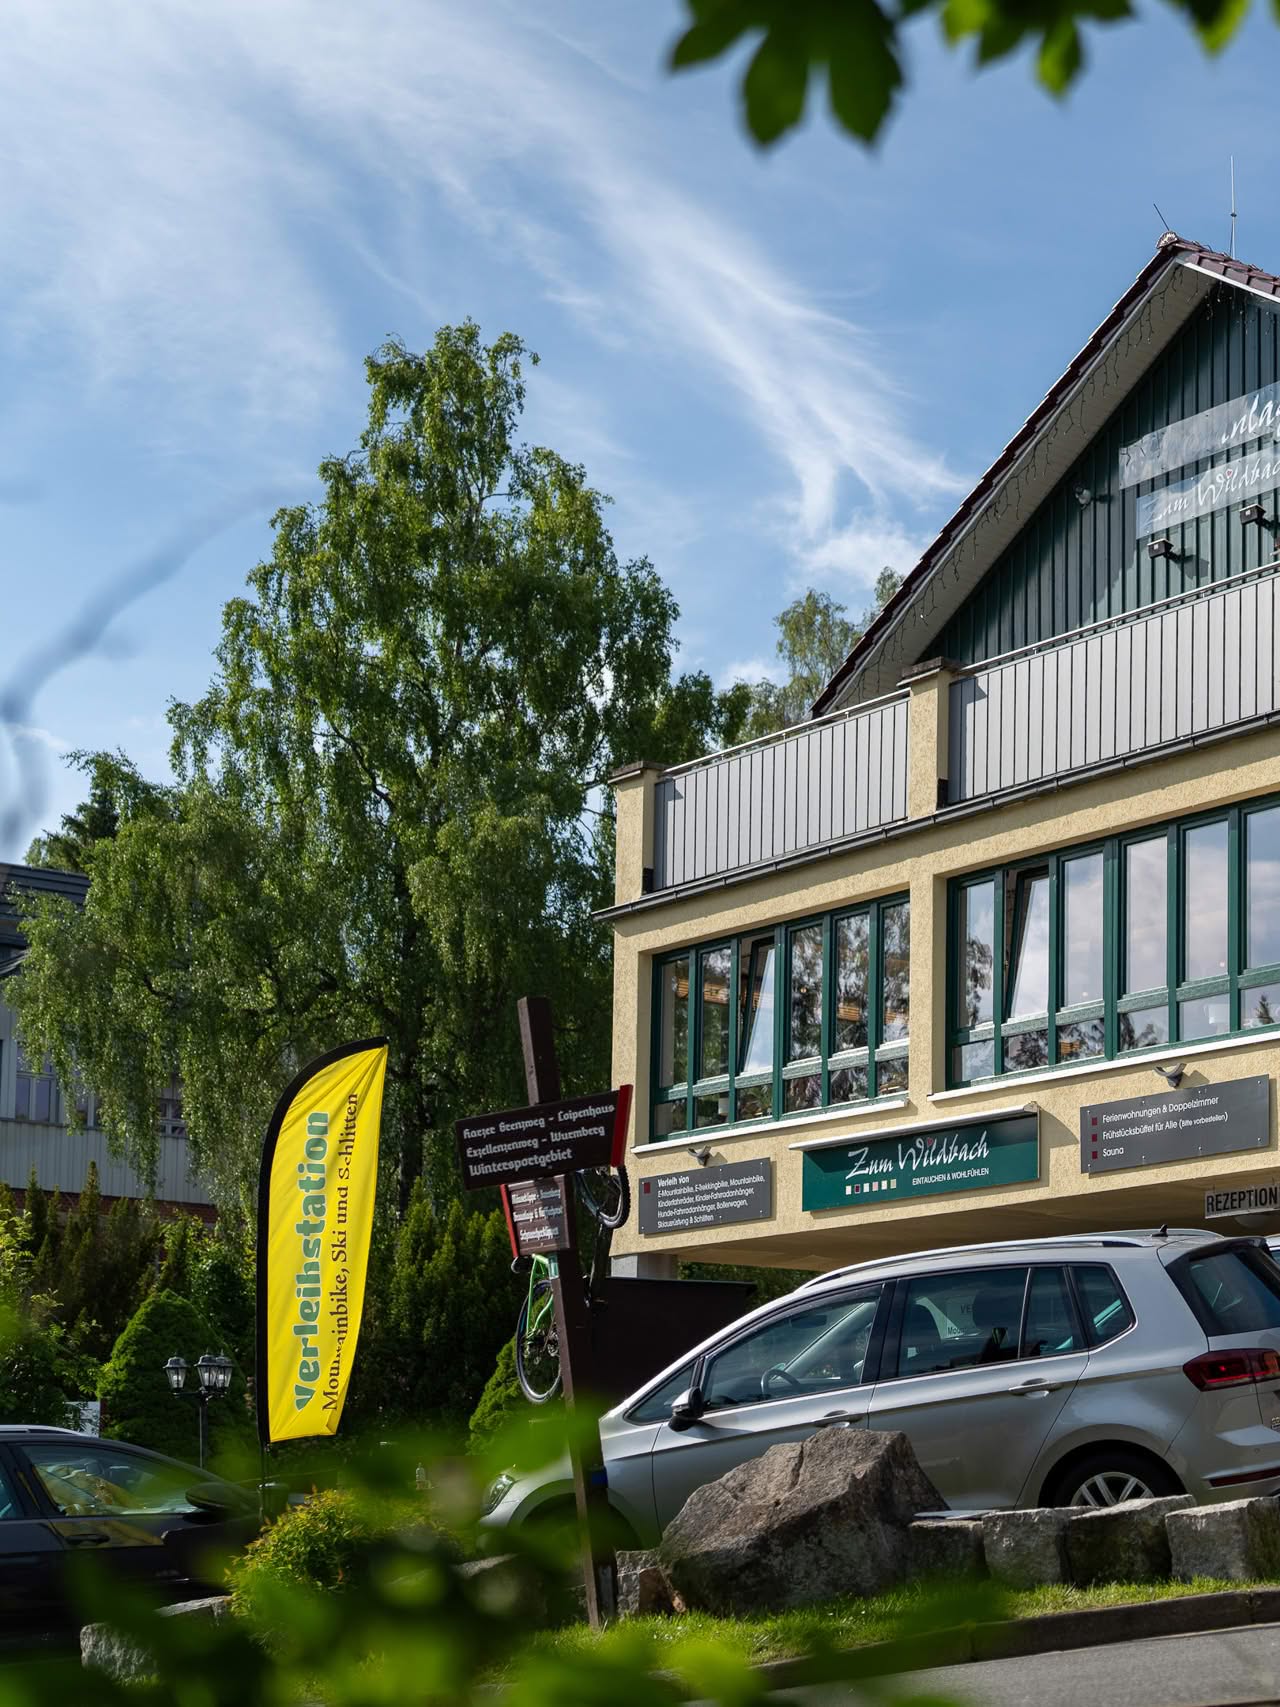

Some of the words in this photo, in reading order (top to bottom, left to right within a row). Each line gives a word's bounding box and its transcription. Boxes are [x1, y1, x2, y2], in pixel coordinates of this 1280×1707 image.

[1102, 1106, 1162, 1124] Ferienwohnungen
[1162, 1105, 1168, 1113] &
[1168, 1095, 1220, 1113] Doppelzimmer
[1154, 1122, 1164, 1132] für
[1165, 1120, 1178, 1130] Alle
[845, 1146, 894, 1180] Zum
[897, 1130, 990, 1171] Wildbach
[1102, 1146, 1124, 1158] Sauna
[657, 1177, 678, 1188] Verleih
[678, 1176, 690, 1186] von
[912, 1174, 945, 1186] EINTAUCHEN
[946, 1173, 952, 1181] &
[951, 1167, 989, 1180] WOHLFÜHLEN
[335, 1186, 350, 1225] und
[1206, 1185, 1279, 1212] REZEPTION
[331, 1229, 348, 1264] Ski
[294, 1111, 331, 1413] Verleihstation
